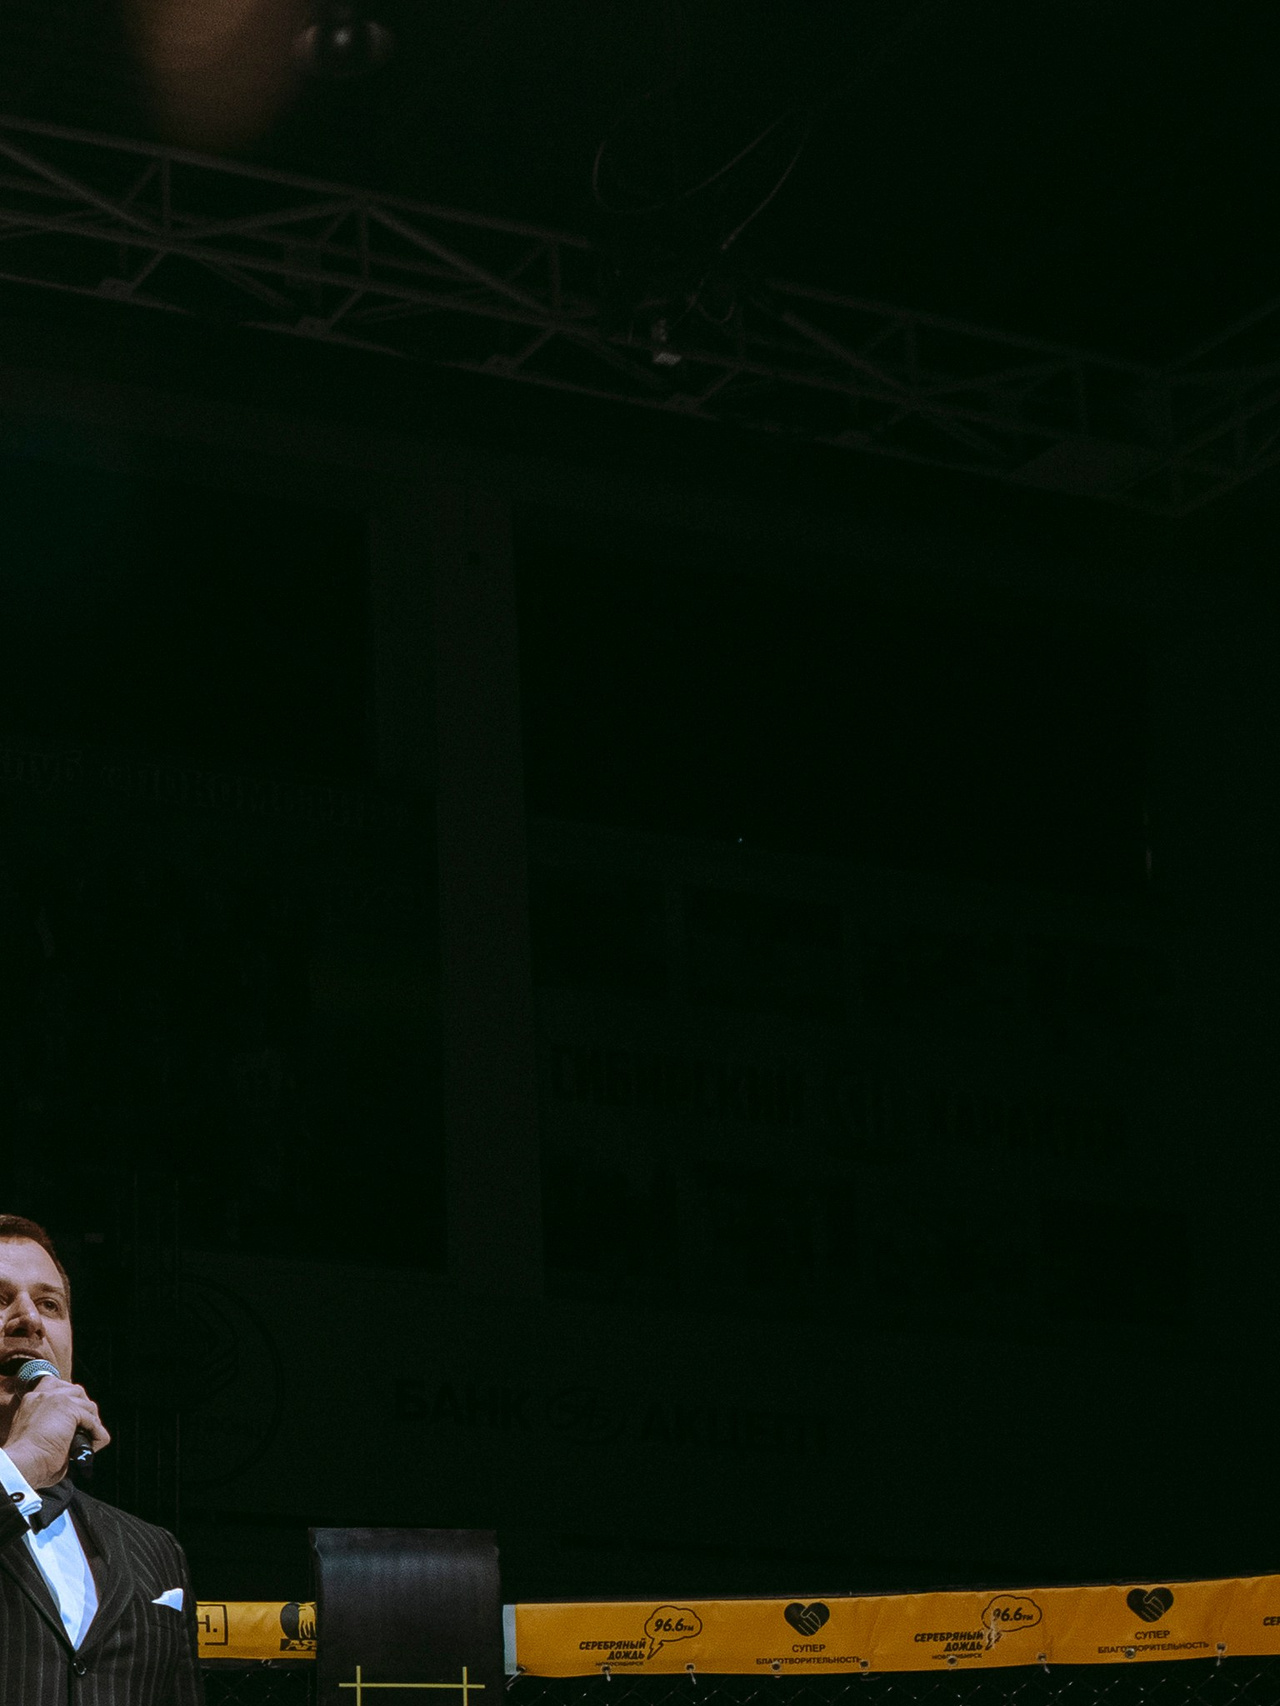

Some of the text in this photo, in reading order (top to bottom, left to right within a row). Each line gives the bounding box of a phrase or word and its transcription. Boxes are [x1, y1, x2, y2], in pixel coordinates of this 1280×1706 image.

[914, 1629, 984, 1643] СЕРЕБРЯНЫЙ
[1135, 1630, 1171, 1641] СУПЕР
[579, 1638, 646, 1651] СЕРЕБРЯНЫЙ
[792, 1643, 826, 1653] СУПЕР
[943, 1641, 983, 1652] ДОЖДЬ
[607, 1650, 645, 1661] ДОЖДЬ
